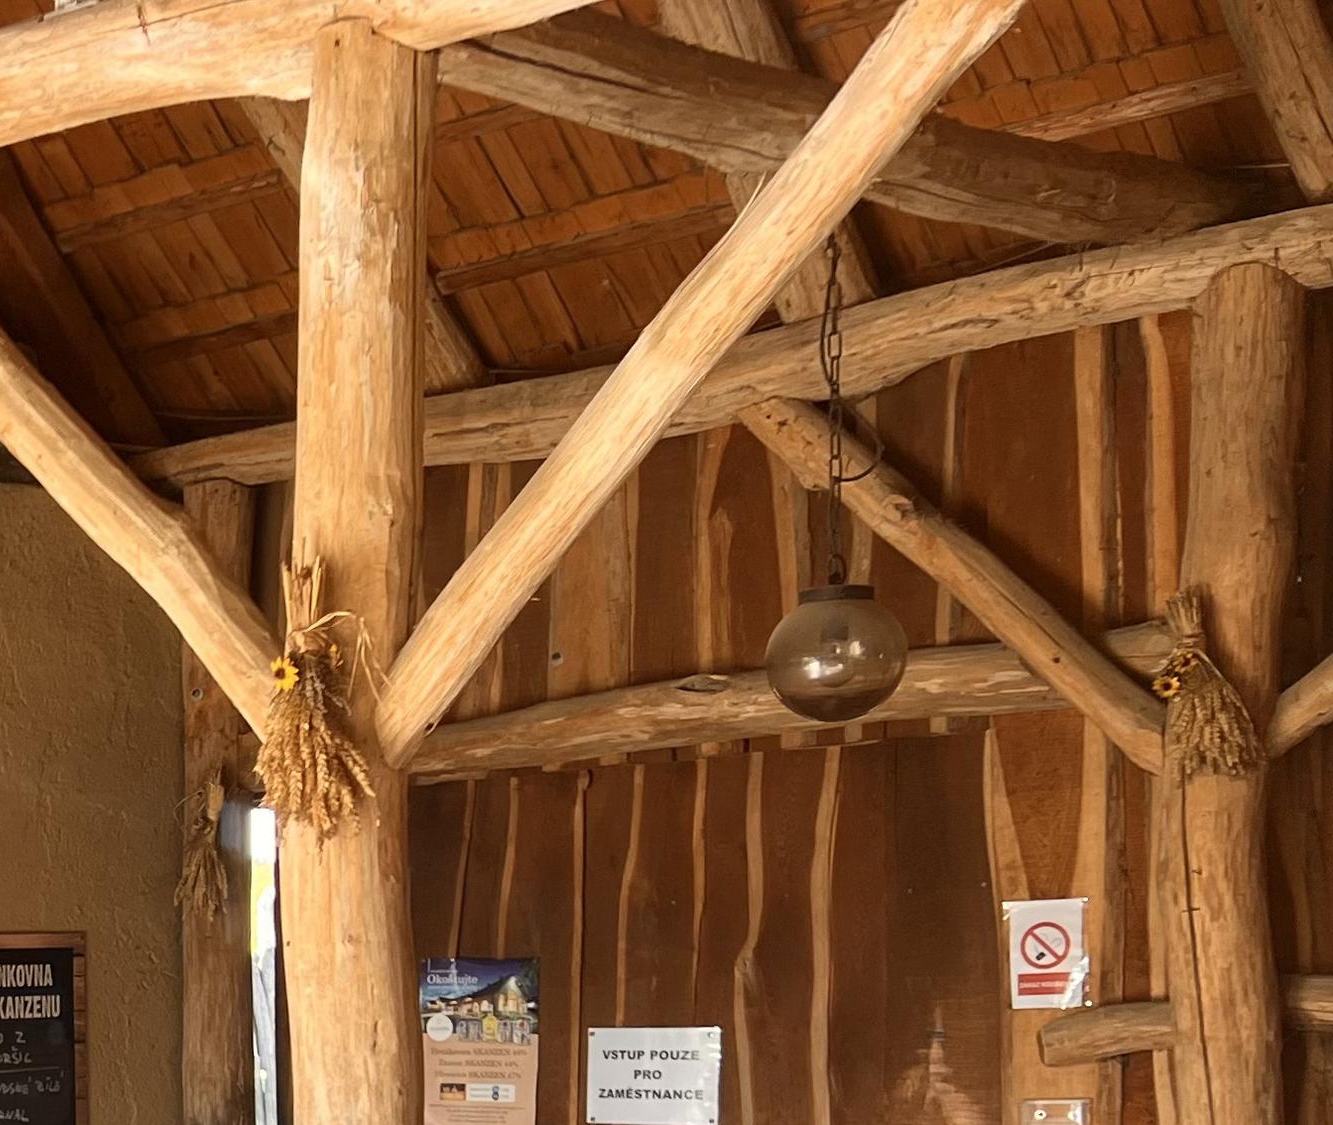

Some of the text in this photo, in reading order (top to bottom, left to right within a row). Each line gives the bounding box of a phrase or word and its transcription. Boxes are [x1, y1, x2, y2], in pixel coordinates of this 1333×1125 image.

[603, 1049, 700, 1061] VSTUP POUZE
[633, 1069, 662, 1080] PRO
[598, 1086, 704, 1100] ZAMĚSTNANCE
